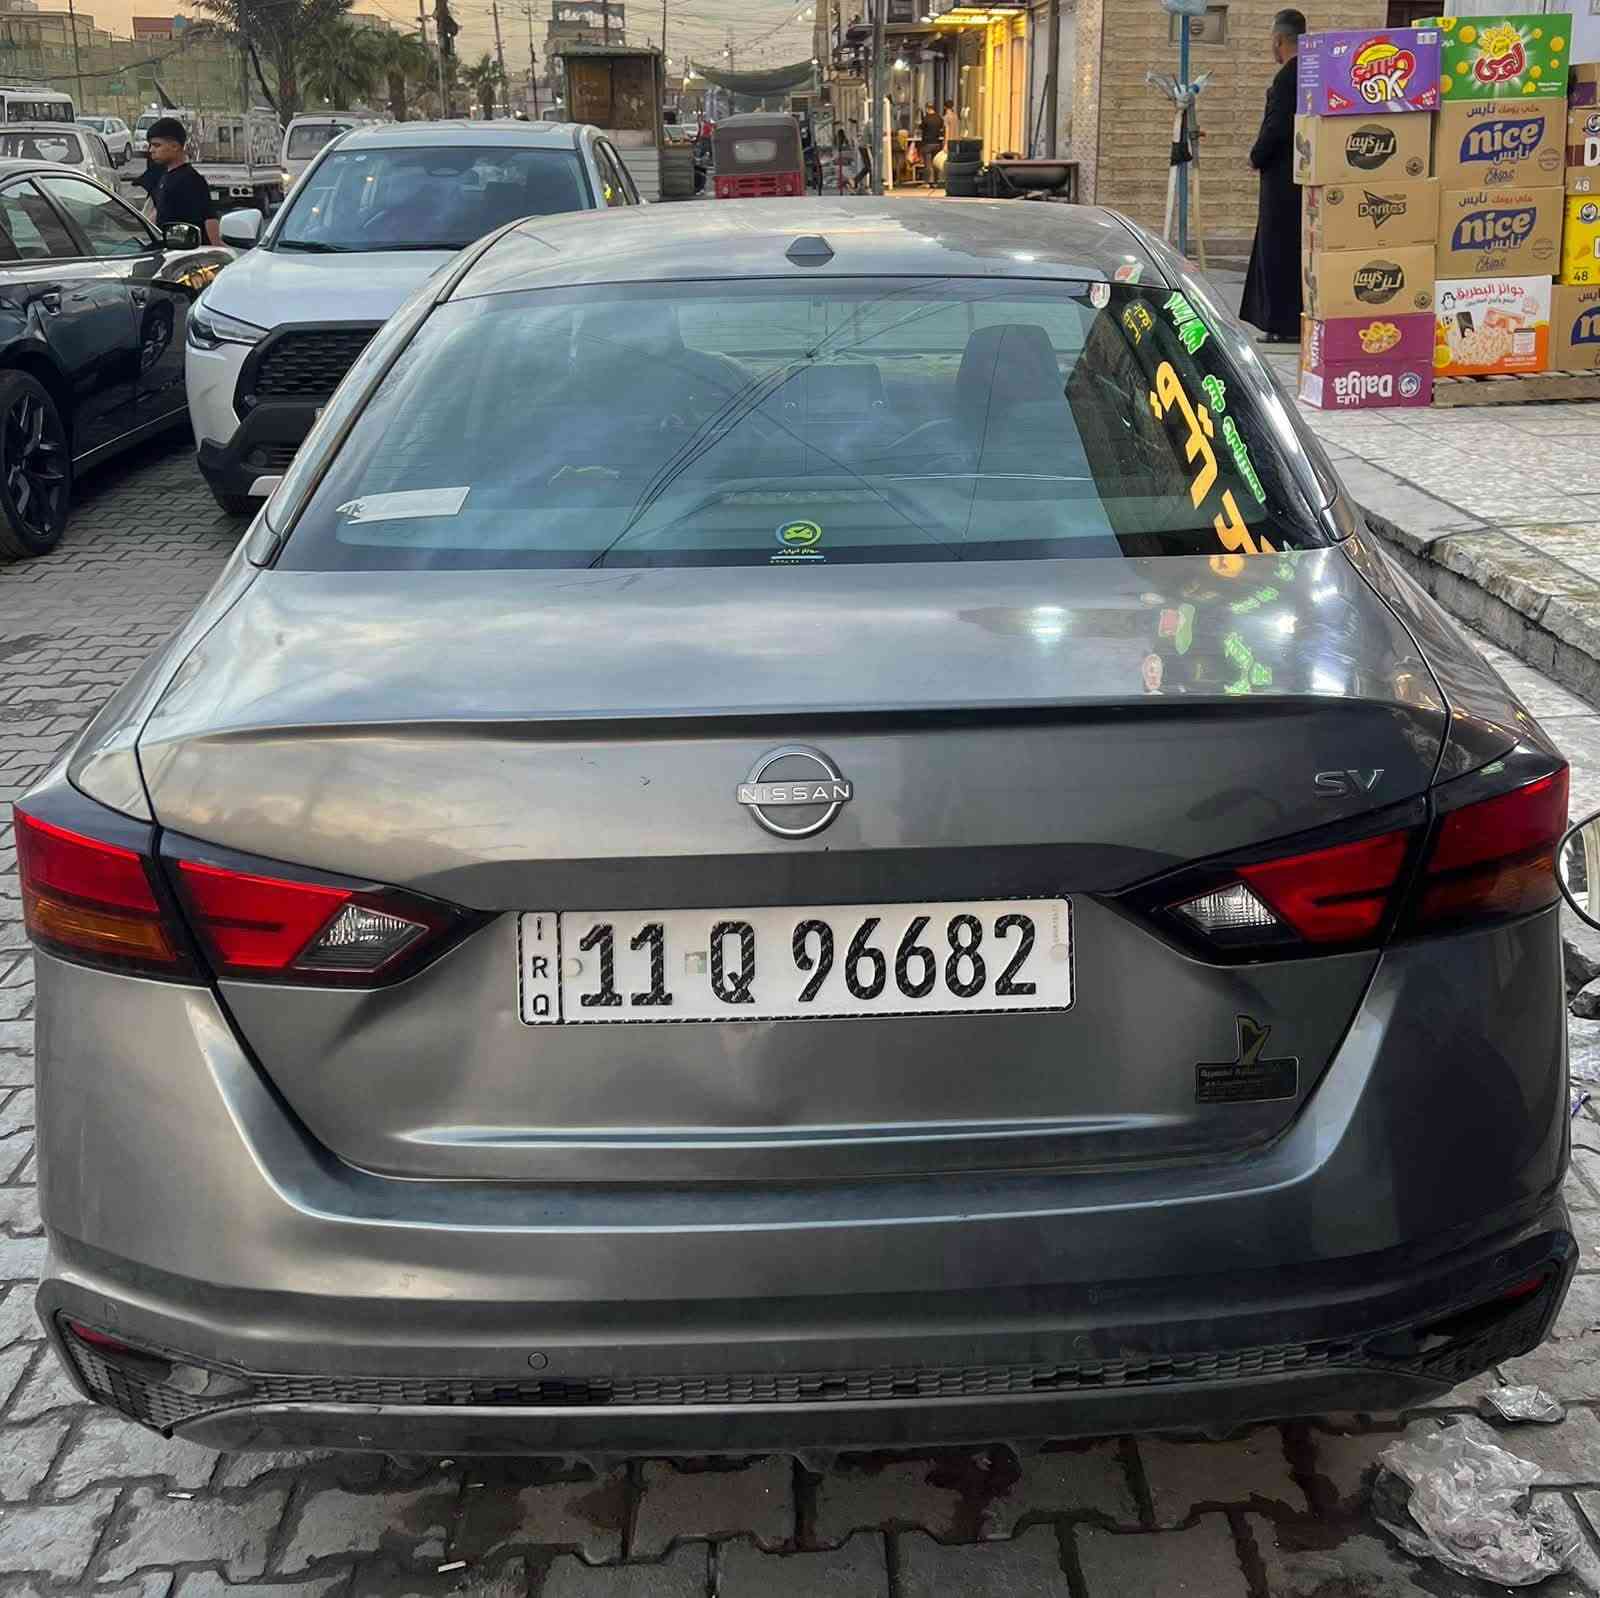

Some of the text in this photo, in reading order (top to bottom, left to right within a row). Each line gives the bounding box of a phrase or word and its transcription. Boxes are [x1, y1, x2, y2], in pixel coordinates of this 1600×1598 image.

[1466, 102, 1496, 118] نايس
[1468, 123, 1539, 156] nice
[1575, 180, 1590, 192] 48
[1458, 191, 1488, 208] نايس
[1358, 202, 1406, 217] Doritos
[1460, 212, 1531, 245] nice
[1574, 271, 1589, 282] 48
[1455, 283, 1525, 300] جوائز البطريق
[1334, 371, 1394, 400] Dalya
[1314, 768, 1385, 797] SV
[740, 784, 850, 801] NISSAN
[578, 920, 673, 1007] 11
[709, 920, 756, 1004] Q
[791, 913, 1037, 1003] 96682
